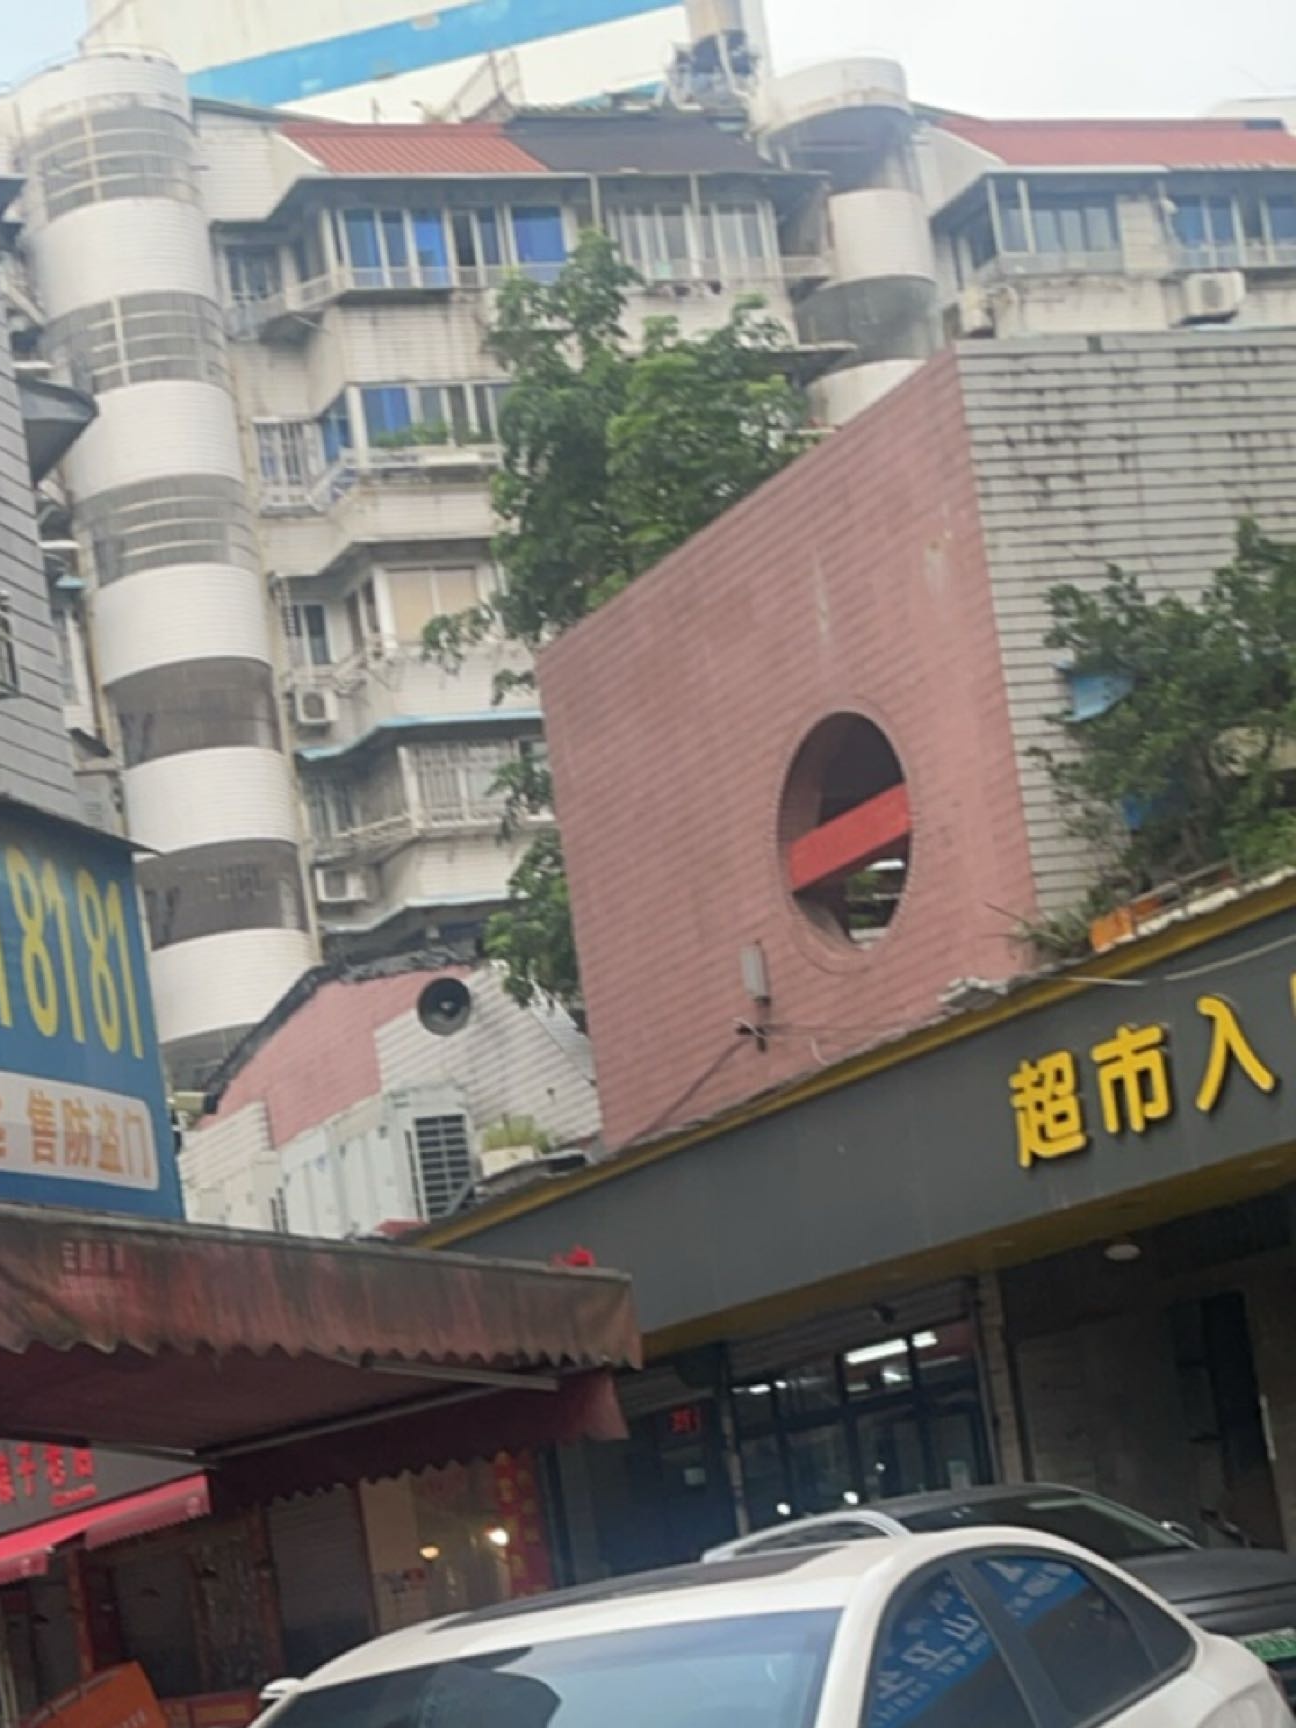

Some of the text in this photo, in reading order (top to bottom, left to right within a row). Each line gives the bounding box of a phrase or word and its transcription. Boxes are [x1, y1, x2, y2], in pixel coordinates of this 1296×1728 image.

[26, 1087, 151, 1179] 售防盗门
[1008, 973, 1296, 1168] 超市入
